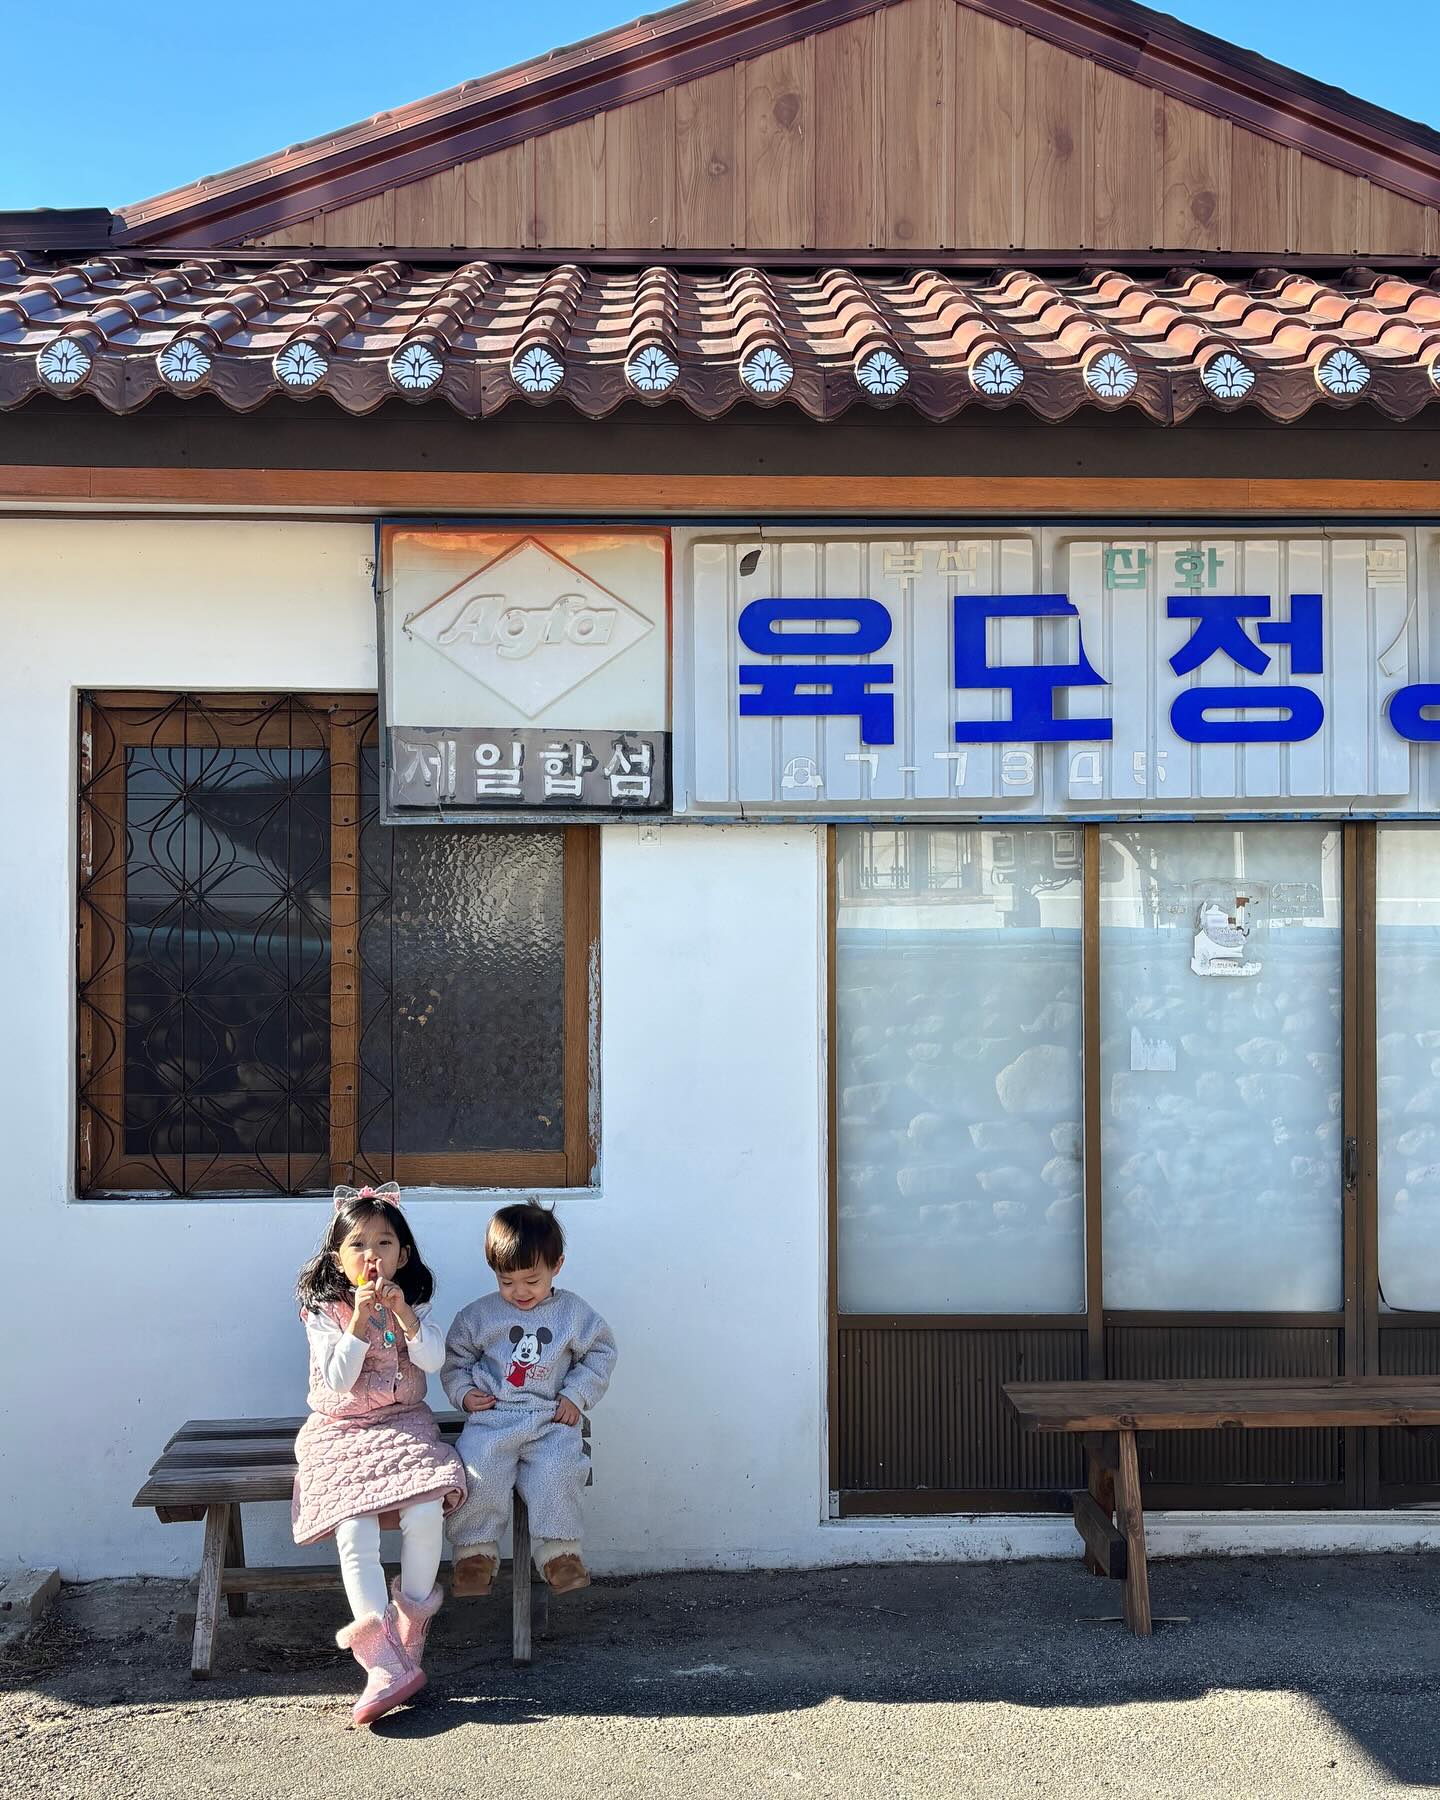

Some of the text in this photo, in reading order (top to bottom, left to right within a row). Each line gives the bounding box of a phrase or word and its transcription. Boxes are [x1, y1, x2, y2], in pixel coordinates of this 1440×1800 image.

[1105, 547, 1225, 590] 잡화
[438, 594, 617, 659] Agfa
[404, 739, 658, 799] 제일합섬
